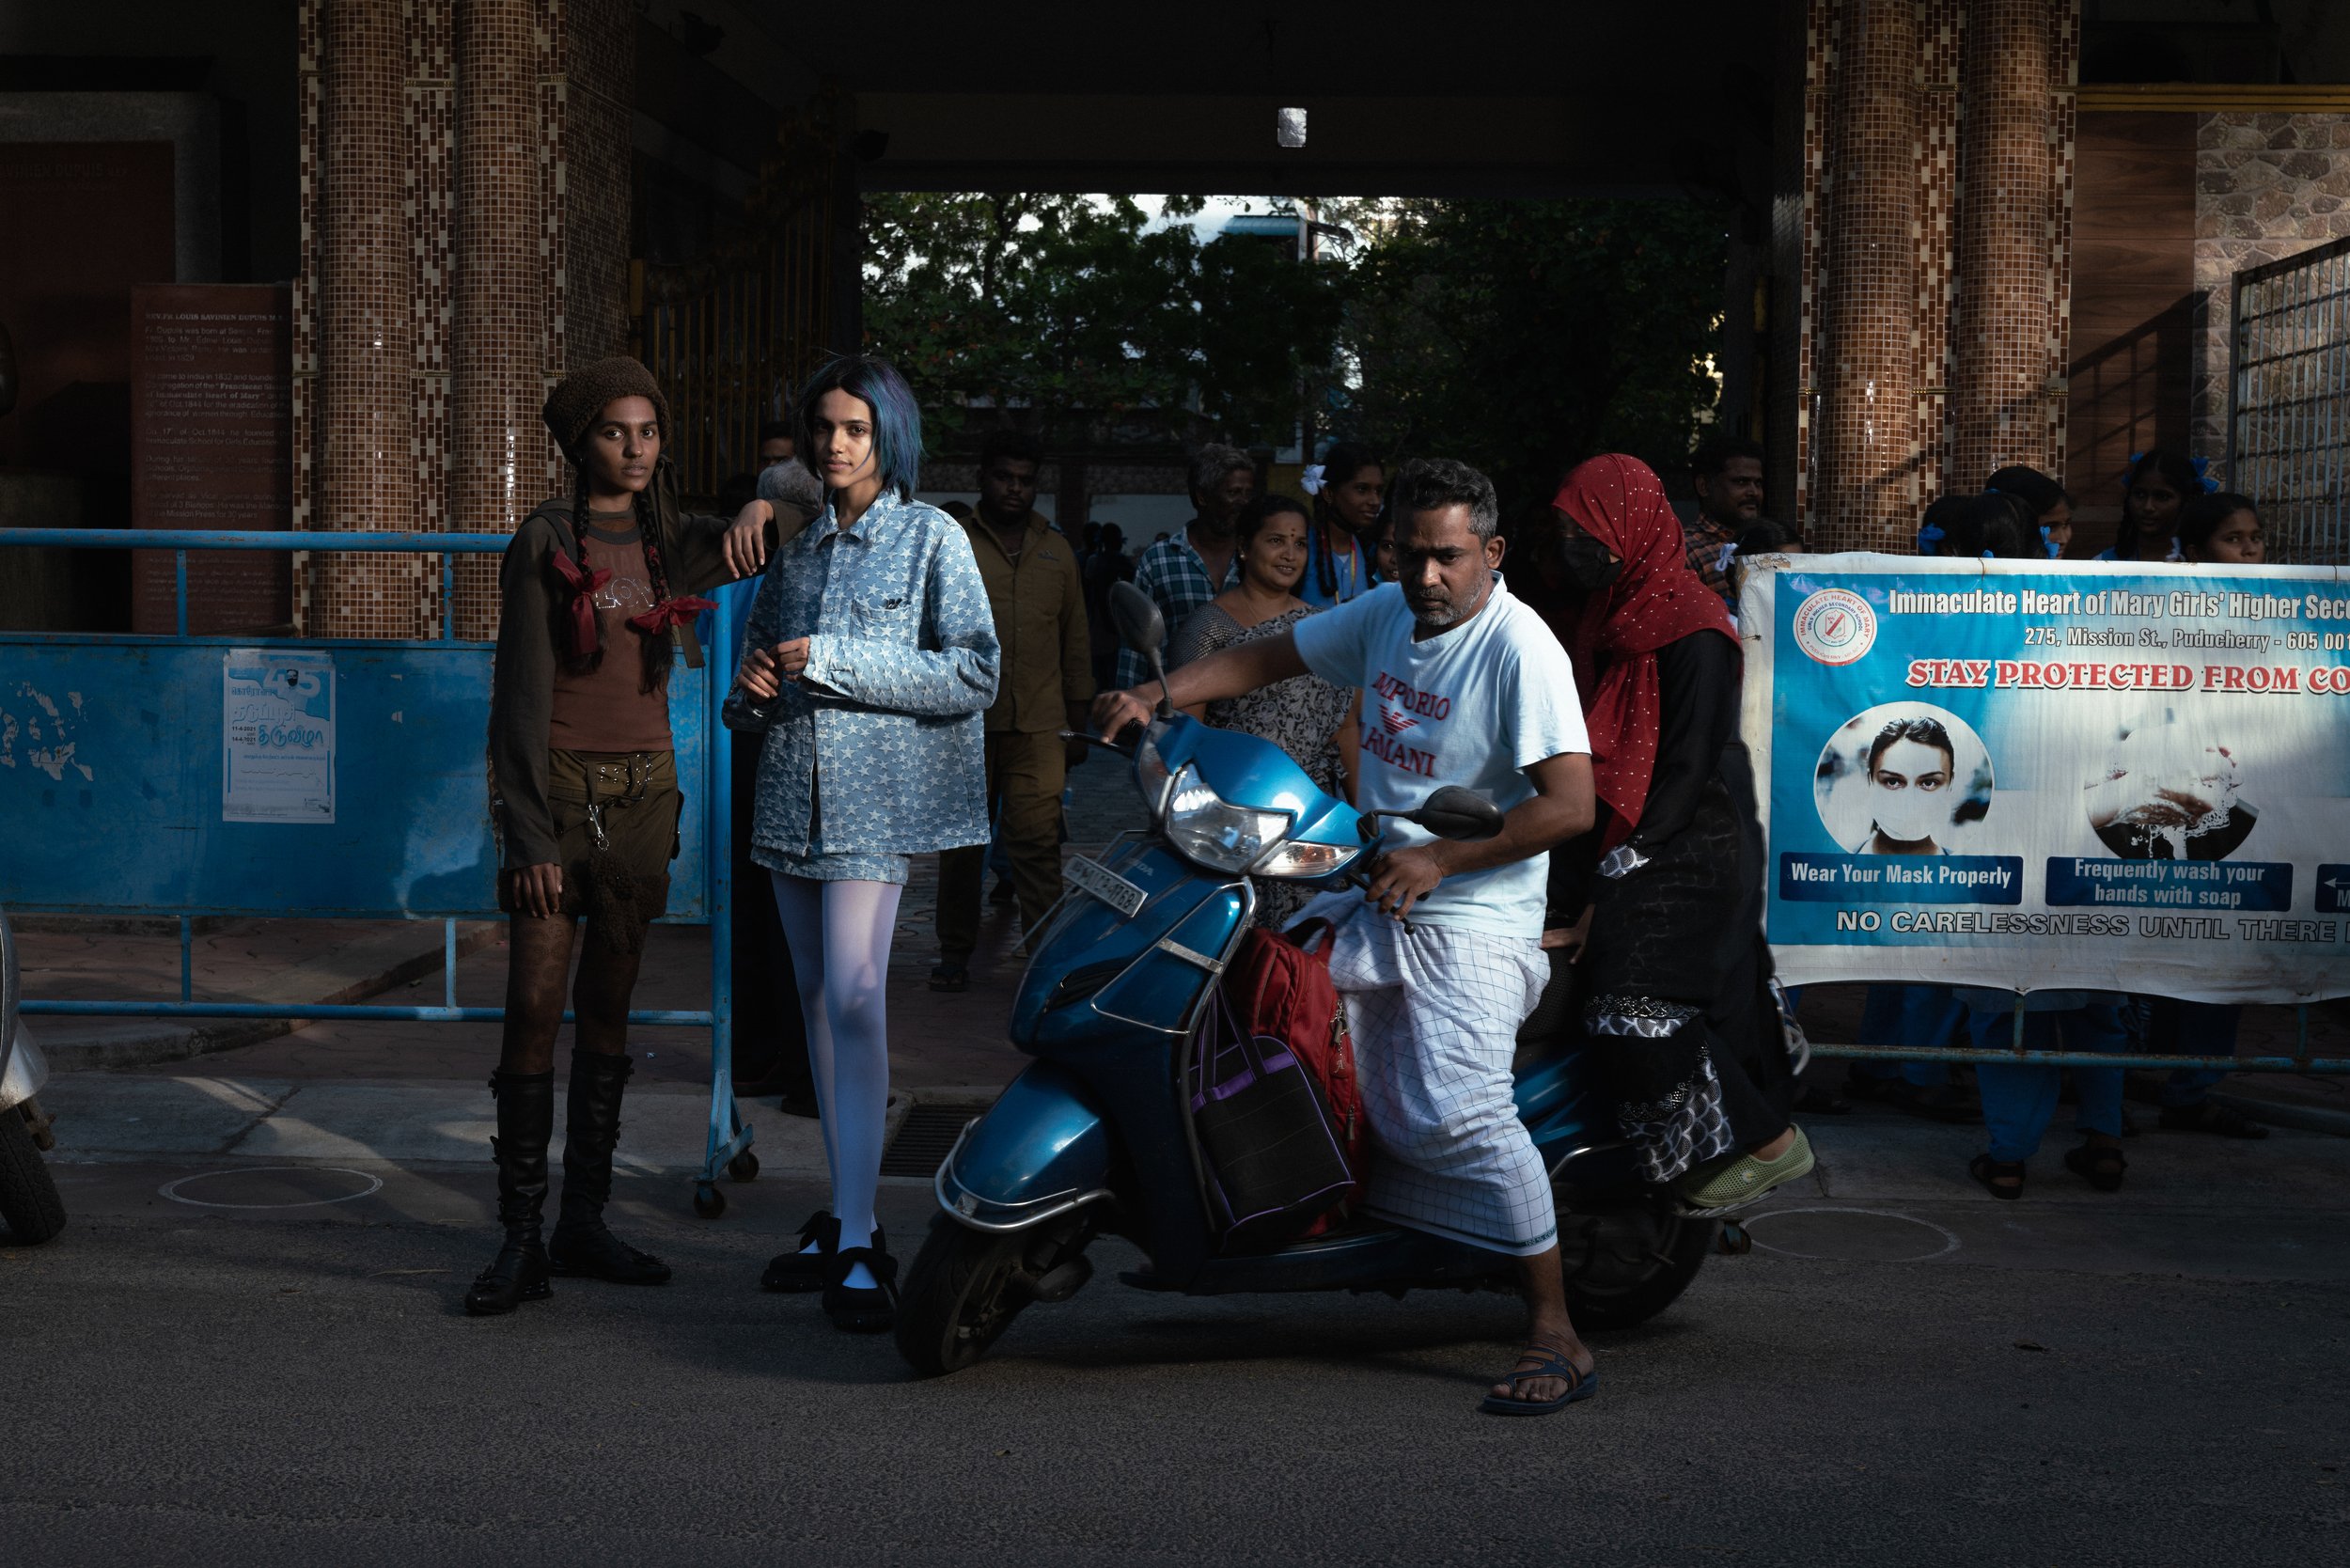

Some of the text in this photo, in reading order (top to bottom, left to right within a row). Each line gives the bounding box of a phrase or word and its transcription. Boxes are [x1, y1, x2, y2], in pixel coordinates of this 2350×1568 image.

[1800, 595, 1828, 635] IMMACULATE
[1830, 594, 1856, 605] HEART
[1857, 604, 1866, 615] OF
[1828, 602, 1856, 614] SECONDARY
[1889, 588, 2017, 614] Immaculate
[2022, 589, 2081, 615] Heart
[2085, 589, 2107, 616] of
[2110, 590, 2165, 619] Mary
[2169, 590, 2225, 618] Girls'
[2229, 592, 2301, 620] Higher
[2024, 627, 2061, 647] 275,
[2067, 627, 2134, 647] Mission
[2139, 628, 2168, 649] St.,
[2172, 629, 2270, 653] Puducherry
[2286, 632, 2318, 651] 605
[1907, 660, 1991, 687] STAY
[1996, 661, 2195, 689] PROTECTED
[2202, 665, 2299, 692] FROM
[1792, 862, 2012, 888] Wear Your Mask Properly
[2075, 858, 2265, 885] Frequently wash your
[2094, 884, 2242, 909] hands with soap
[1836, 910, 1881, 933] NO
[1890, 911, 2129, 936] CARELESSNESS
[2138, 916, 2231, 940] UNTIL
[2237, 918, 2337, 942] THERE
